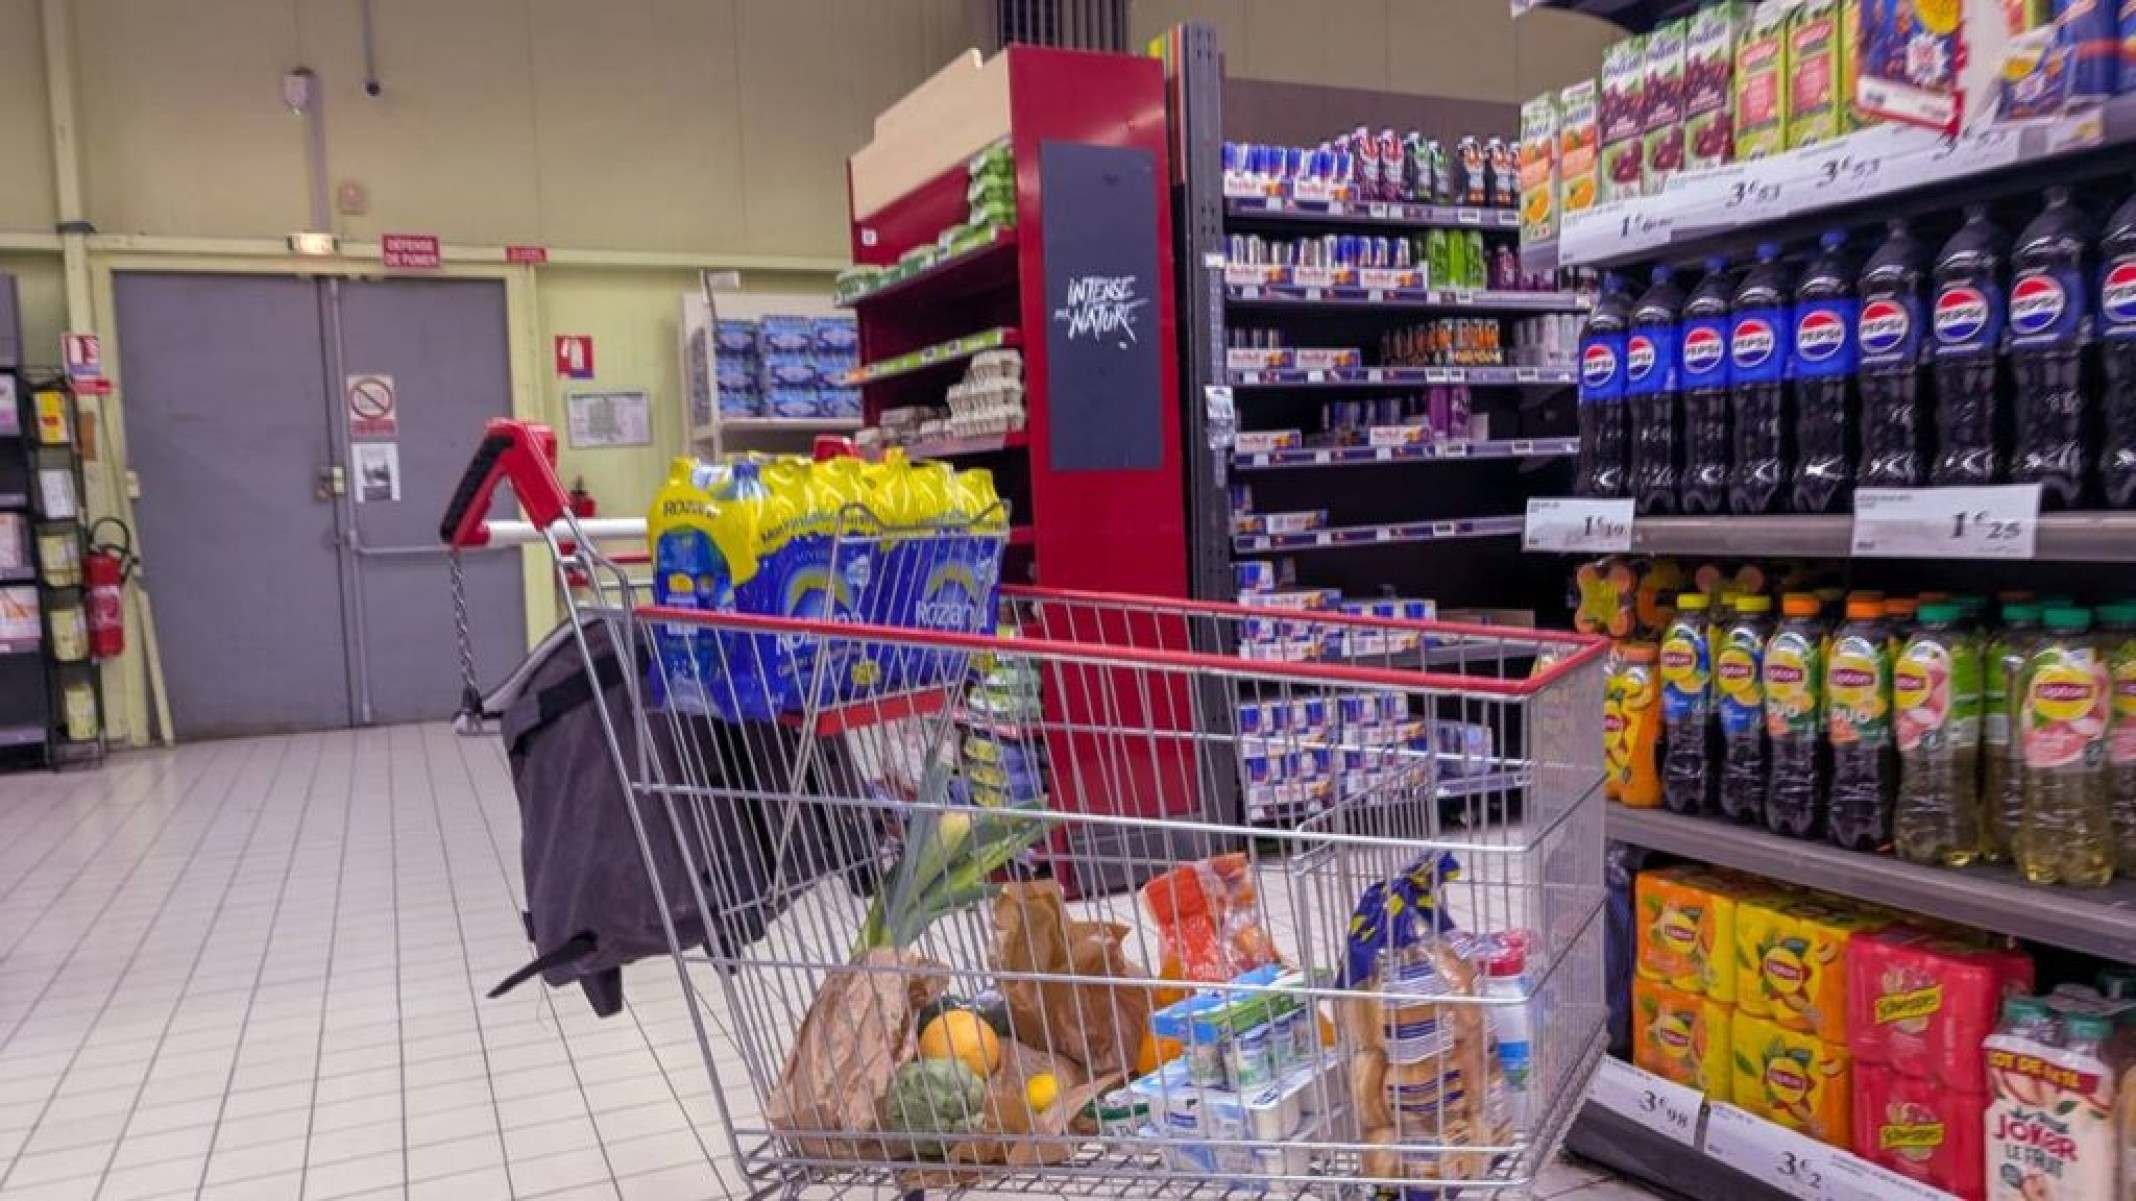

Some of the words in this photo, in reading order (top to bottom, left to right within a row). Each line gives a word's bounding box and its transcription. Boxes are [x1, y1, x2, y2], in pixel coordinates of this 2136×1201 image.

[1067, 275, 1136, 307] INTENSE
[1951, 511, 2022, 540] 1€25
[2037, 680, 2091, 698] Lipton
